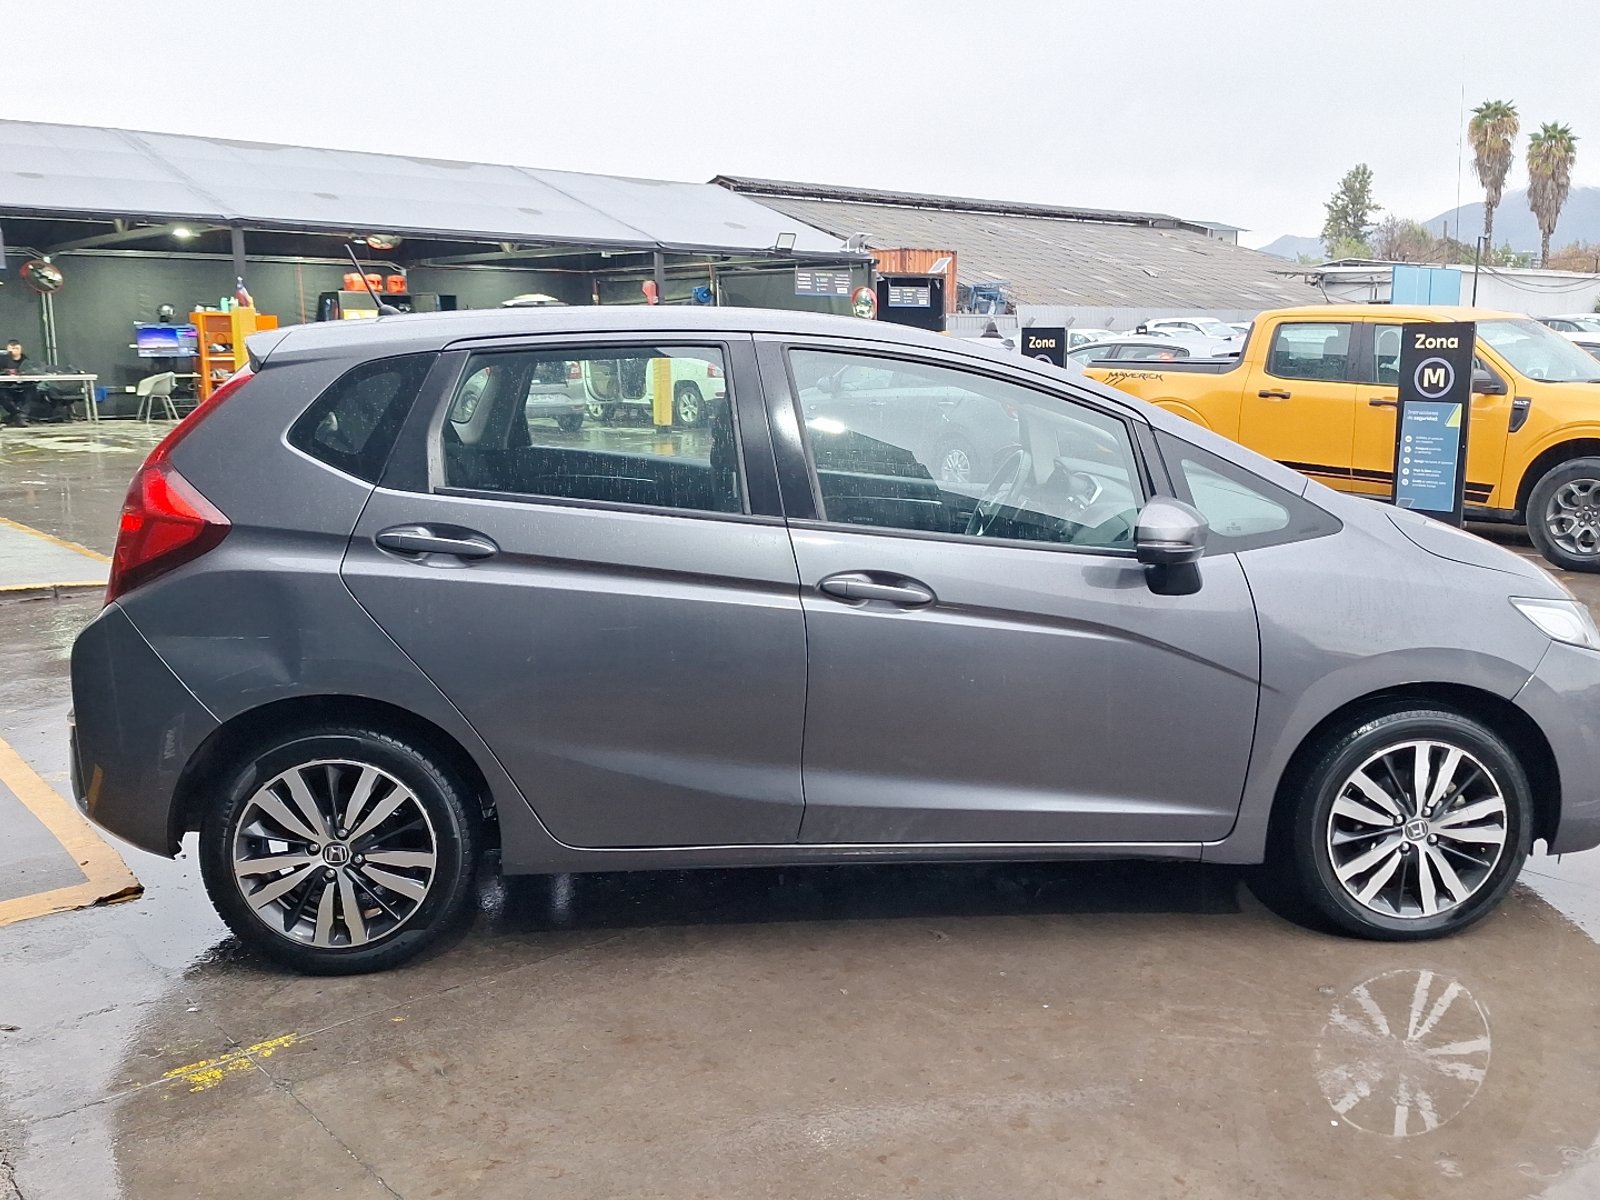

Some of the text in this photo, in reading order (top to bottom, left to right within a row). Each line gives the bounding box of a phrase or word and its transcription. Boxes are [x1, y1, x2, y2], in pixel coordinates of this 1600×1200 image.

[1028, 336, 1056, 349] Zona
[1414, 333, 1459, 349] Zona
[1104, 372, 1164, 384] MAVERICK
[1423, 368, 1445, 388] M
